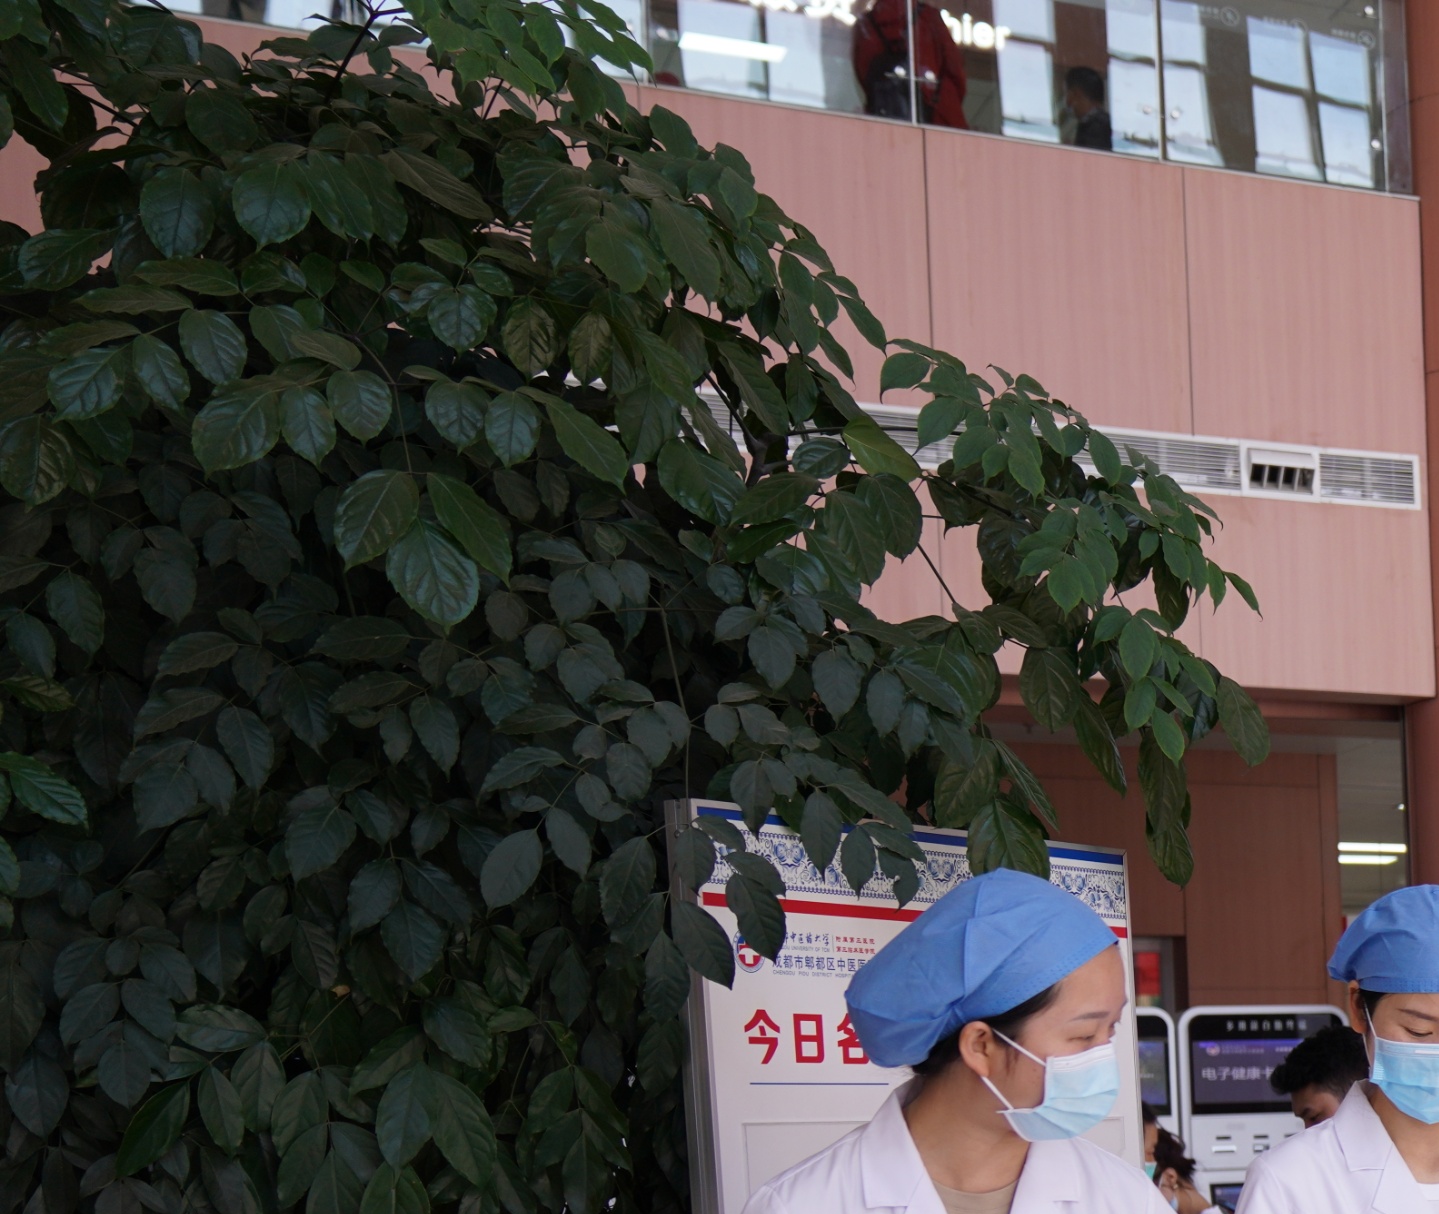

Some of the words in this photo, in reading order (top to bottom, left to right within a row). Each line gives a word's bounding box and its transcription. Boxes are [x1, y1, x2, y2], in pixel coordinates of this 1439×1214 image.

[772, 954, 870, 972] 成都市郫都区中医医
